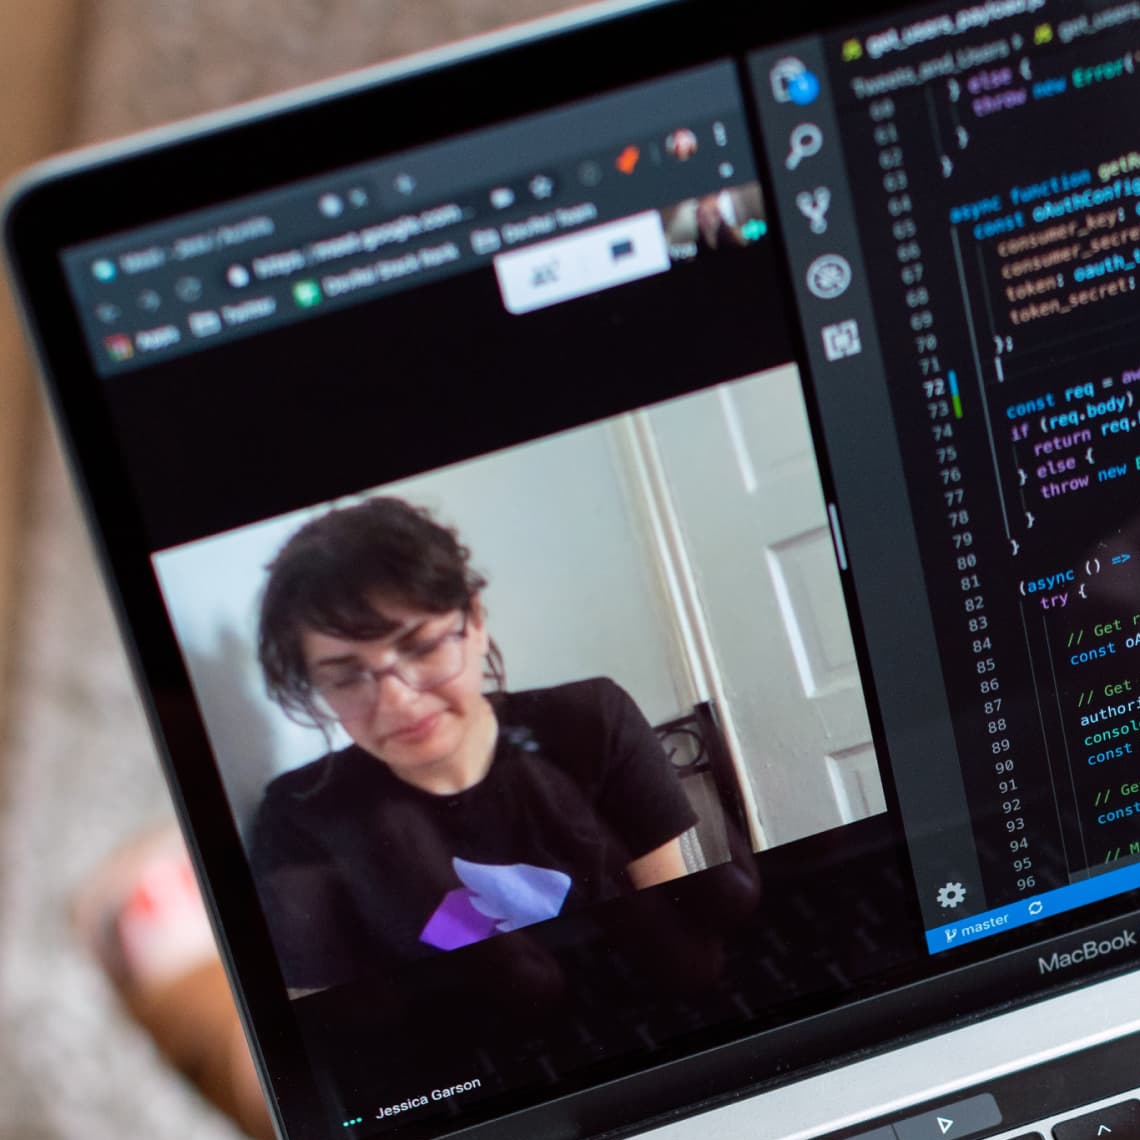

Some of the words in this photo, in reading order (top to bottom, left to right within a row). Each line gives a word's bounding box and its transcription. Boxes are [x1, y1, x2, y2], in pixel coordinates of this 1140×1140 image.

[949, 195, 1000, 224] async
[1009, 169, 1091, 204] function
[972, 211, 1023, 241] const
[997, 207, 1125, 258] consumer_key:
[1005, 273, 1064, 302] token:
[1009, 276, 1136, 324] token_secret:
[1005, 392, 1056, 420] const
[1064, 381, 1095, 402] req
[1011, 422, 1029, 442] if
[1040, 390, 1134, 433] (req.body)
[1033, 429, 1092, 457] return
[1035, 457, 1076, 479] else
[1040, 474, 1090, 499] throw
[1096, 462, 1128, 483] new
[1018, 568, 1075, 597] (async
[1039, 592, 1068, 609] try
[1093, 618, 1122, 637] Get
[1069, 641, 1116, 666] const
[1103, 679, 1132, 697] Get
[1086, 742, 1133, 766] const
[1001, 797, 1022, 814] 92
[1005, 816, 1025, 833] 93
[1009, 836, 1029, 853] 94
[1012, 856, 1032, 873] 95
[1016, 874, 1036, 891] 96
[960, 913, 1009, 937] master
[1038, 930, 1137, 975] MacBook
[375, 1094, 429, 1119] Jessica
[431, 1078, 481, 1101] Garson
